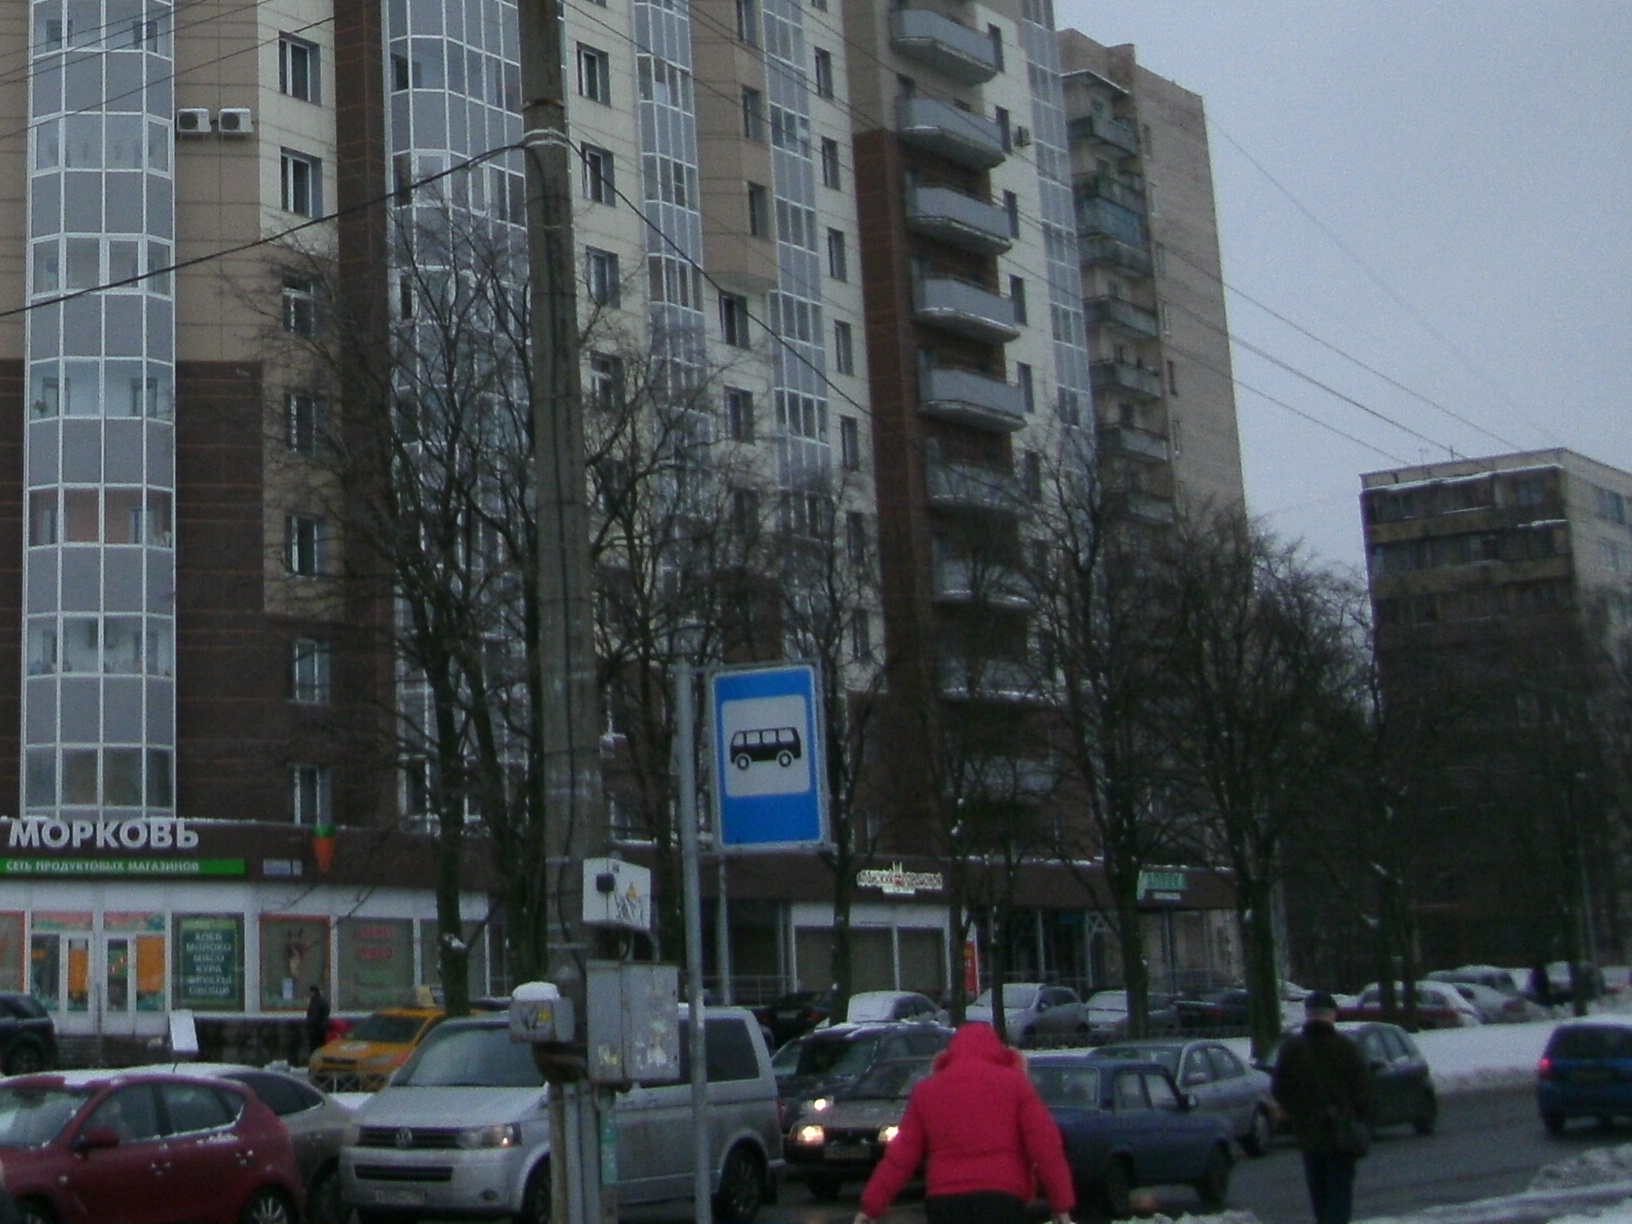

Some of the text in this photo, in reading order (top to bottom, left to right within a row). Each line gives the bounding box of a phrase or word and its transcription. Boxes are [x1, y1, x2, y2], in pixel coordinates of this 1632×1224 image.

[8, 819, 200, 849] МОРКОВЬ
[6, 861, 200, 873] СЕТЬ ПРОДУКТОВЫХ МАГАЗИНОВ
